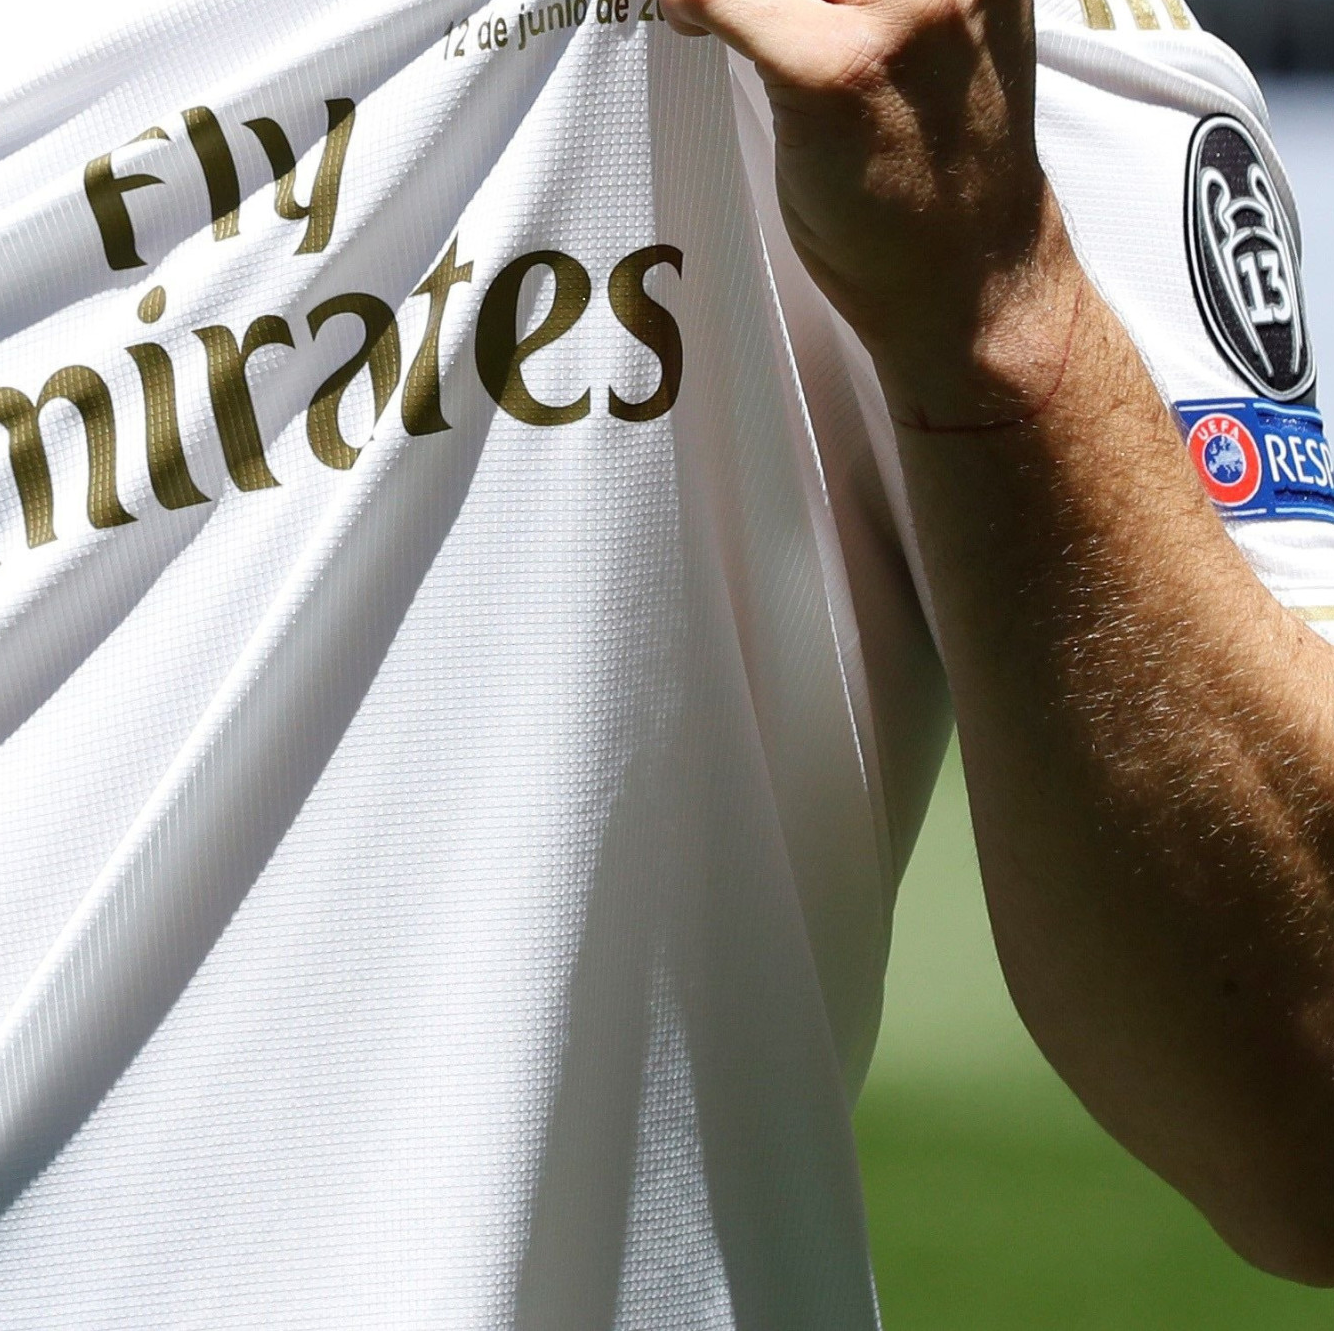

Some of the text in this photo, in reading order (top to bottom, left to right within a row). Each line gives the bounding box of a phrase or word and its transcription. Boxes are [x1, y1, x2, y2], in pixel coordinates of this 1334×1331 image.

[443, 19, 469, 60] 12
[478, 11, 508, 50] de
[85, 97, 355, 270] Fly
[1238, 250, 1291, 323] 13
[1198, 420, 1239, 441] UEFA
